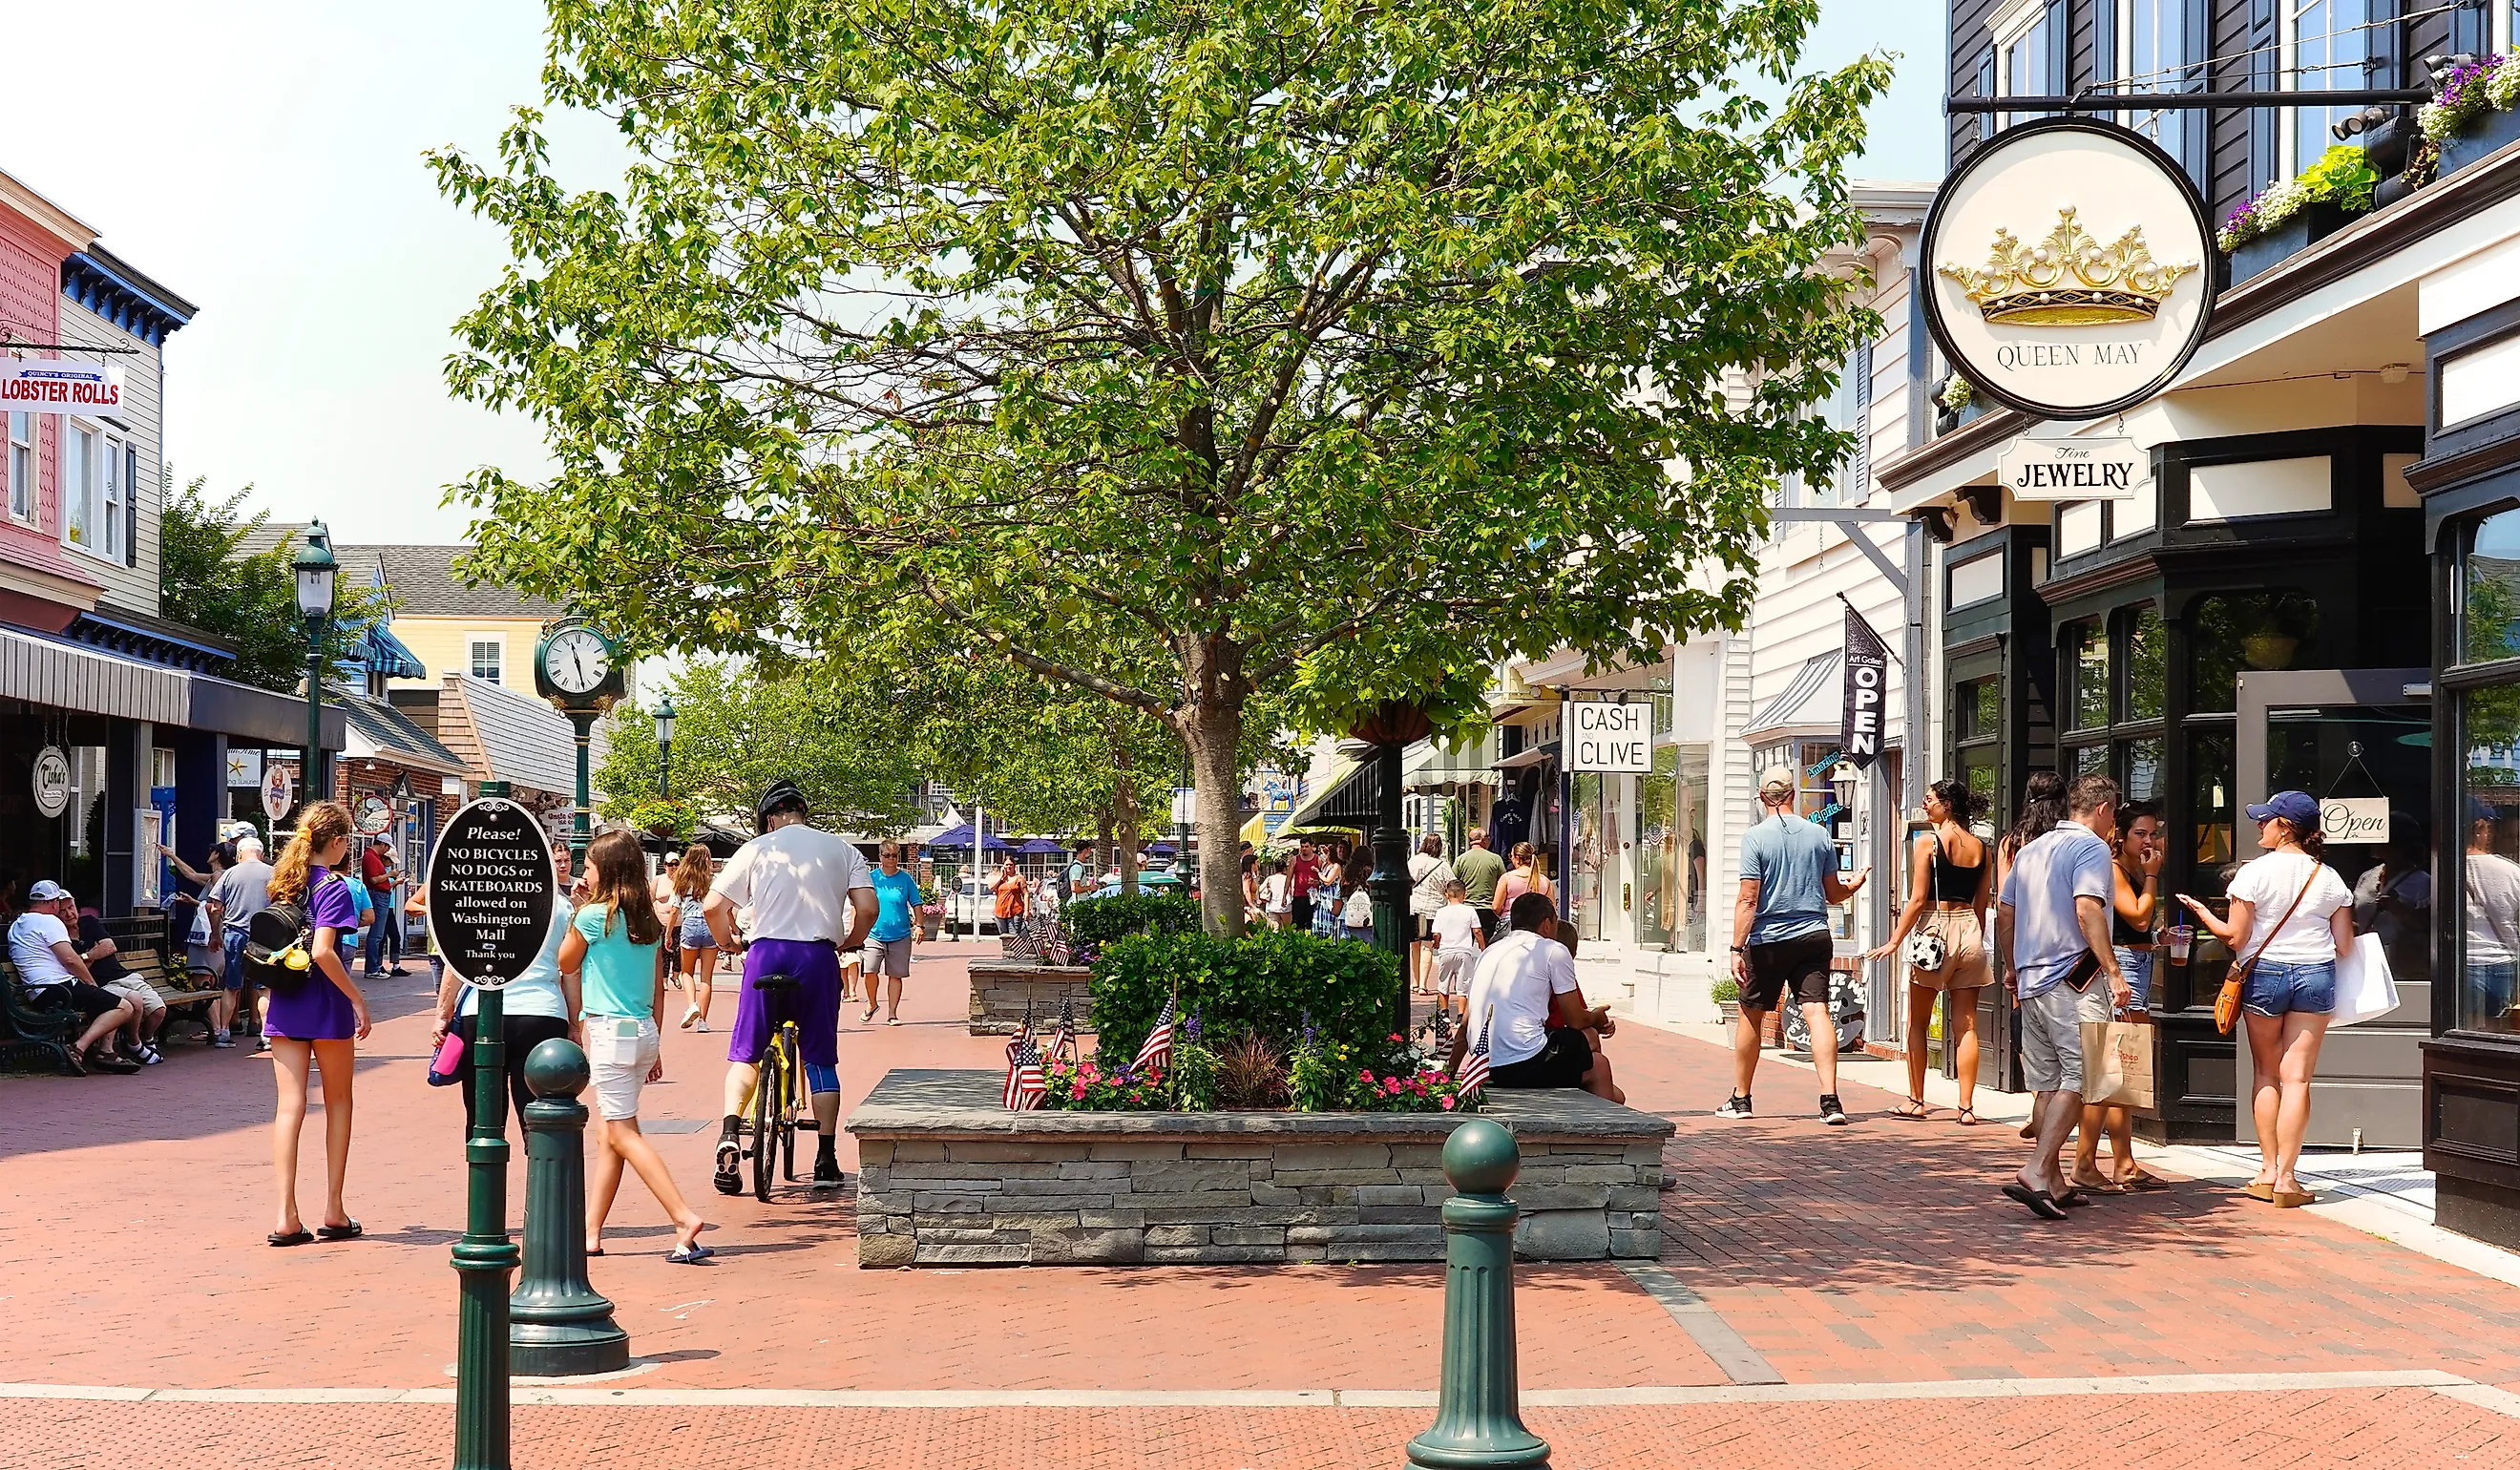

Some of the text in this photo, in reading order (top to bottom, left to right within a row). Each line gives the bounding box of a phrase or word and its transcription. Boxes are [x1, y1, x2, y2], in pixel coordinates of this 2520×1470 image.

[1997, 344, 2142, 371] QUEEN MAY
[2, 379, 118, 405] LOBSTER ROLLS
[2055, 448, 2090, 459] Fine
[2017, 463, 2133, 490] JEWELRY
[1861, 656, 1883, 667] Gallery
[1852, 667, 1879, 755] OPEN
[1582, 707, 1638, 730] CASH
[1581, 742, 1644, 765] CLIVE
[1807, 752, 1839, 778] Amazing
[2323, 804, 2385, 840] Open
[467, 827, 521, 840] Please!
[448, 849, 538, 861] NO BICYCLES
[451, 864, 472, 875] NO
[477, 865, 516, 876] DOGS
[440, 880, 543, 892] SKATEBOARDS
[454, 896, 507, 908] allowed
[452, 913, 531, 928] Washington
[475, 929, 506, 940] Mall
[465, 950, 515, 960] Thank you
